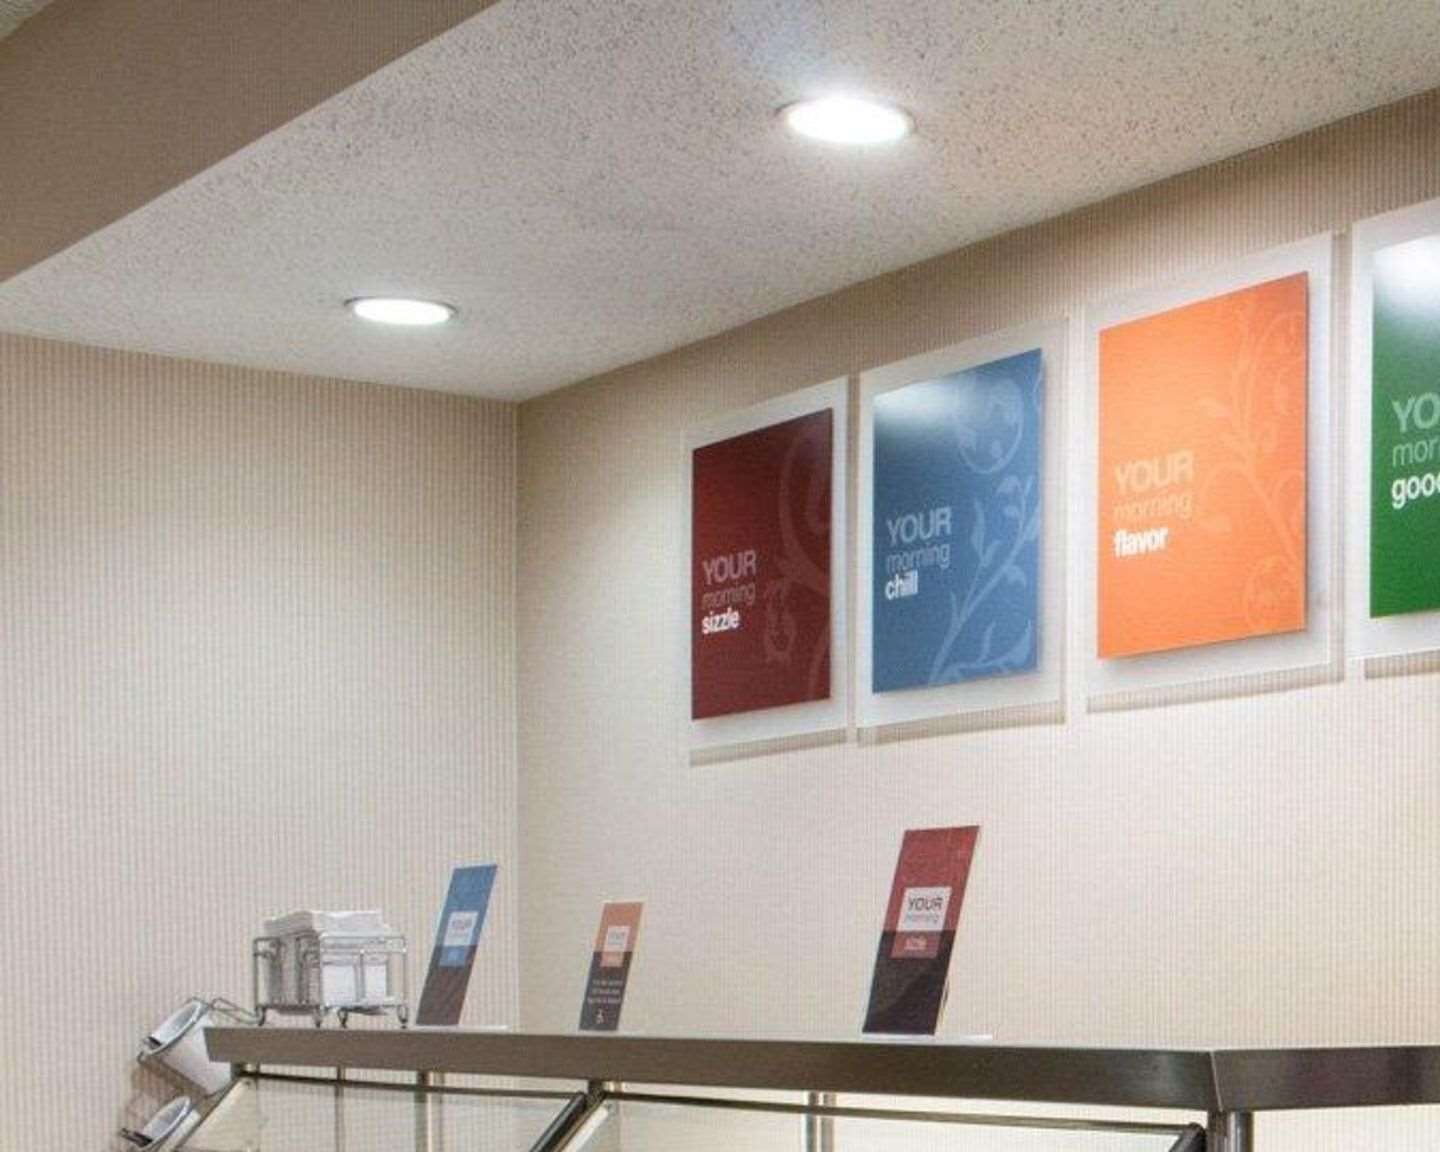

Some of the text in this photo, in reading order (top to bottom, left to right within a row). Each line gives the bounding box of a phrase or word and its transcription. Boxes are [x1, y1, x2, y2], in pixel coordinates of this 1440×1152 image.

[1113, 449, 1194, 492] YOUR
[1113, 489, 1193, 522] morning
[886, 507, 953, 546] YOUR
[885, 542, 951, 570] morning
[1113, 527, 1169, 558] flavor
[702, 550, 757, 586] YOUR
[702, 580, 757, 610] morning
[885, 569, 919, 600] chill
[702, 606, 740, 635] sizzle
[907, 896, 944, 912] YOUR
